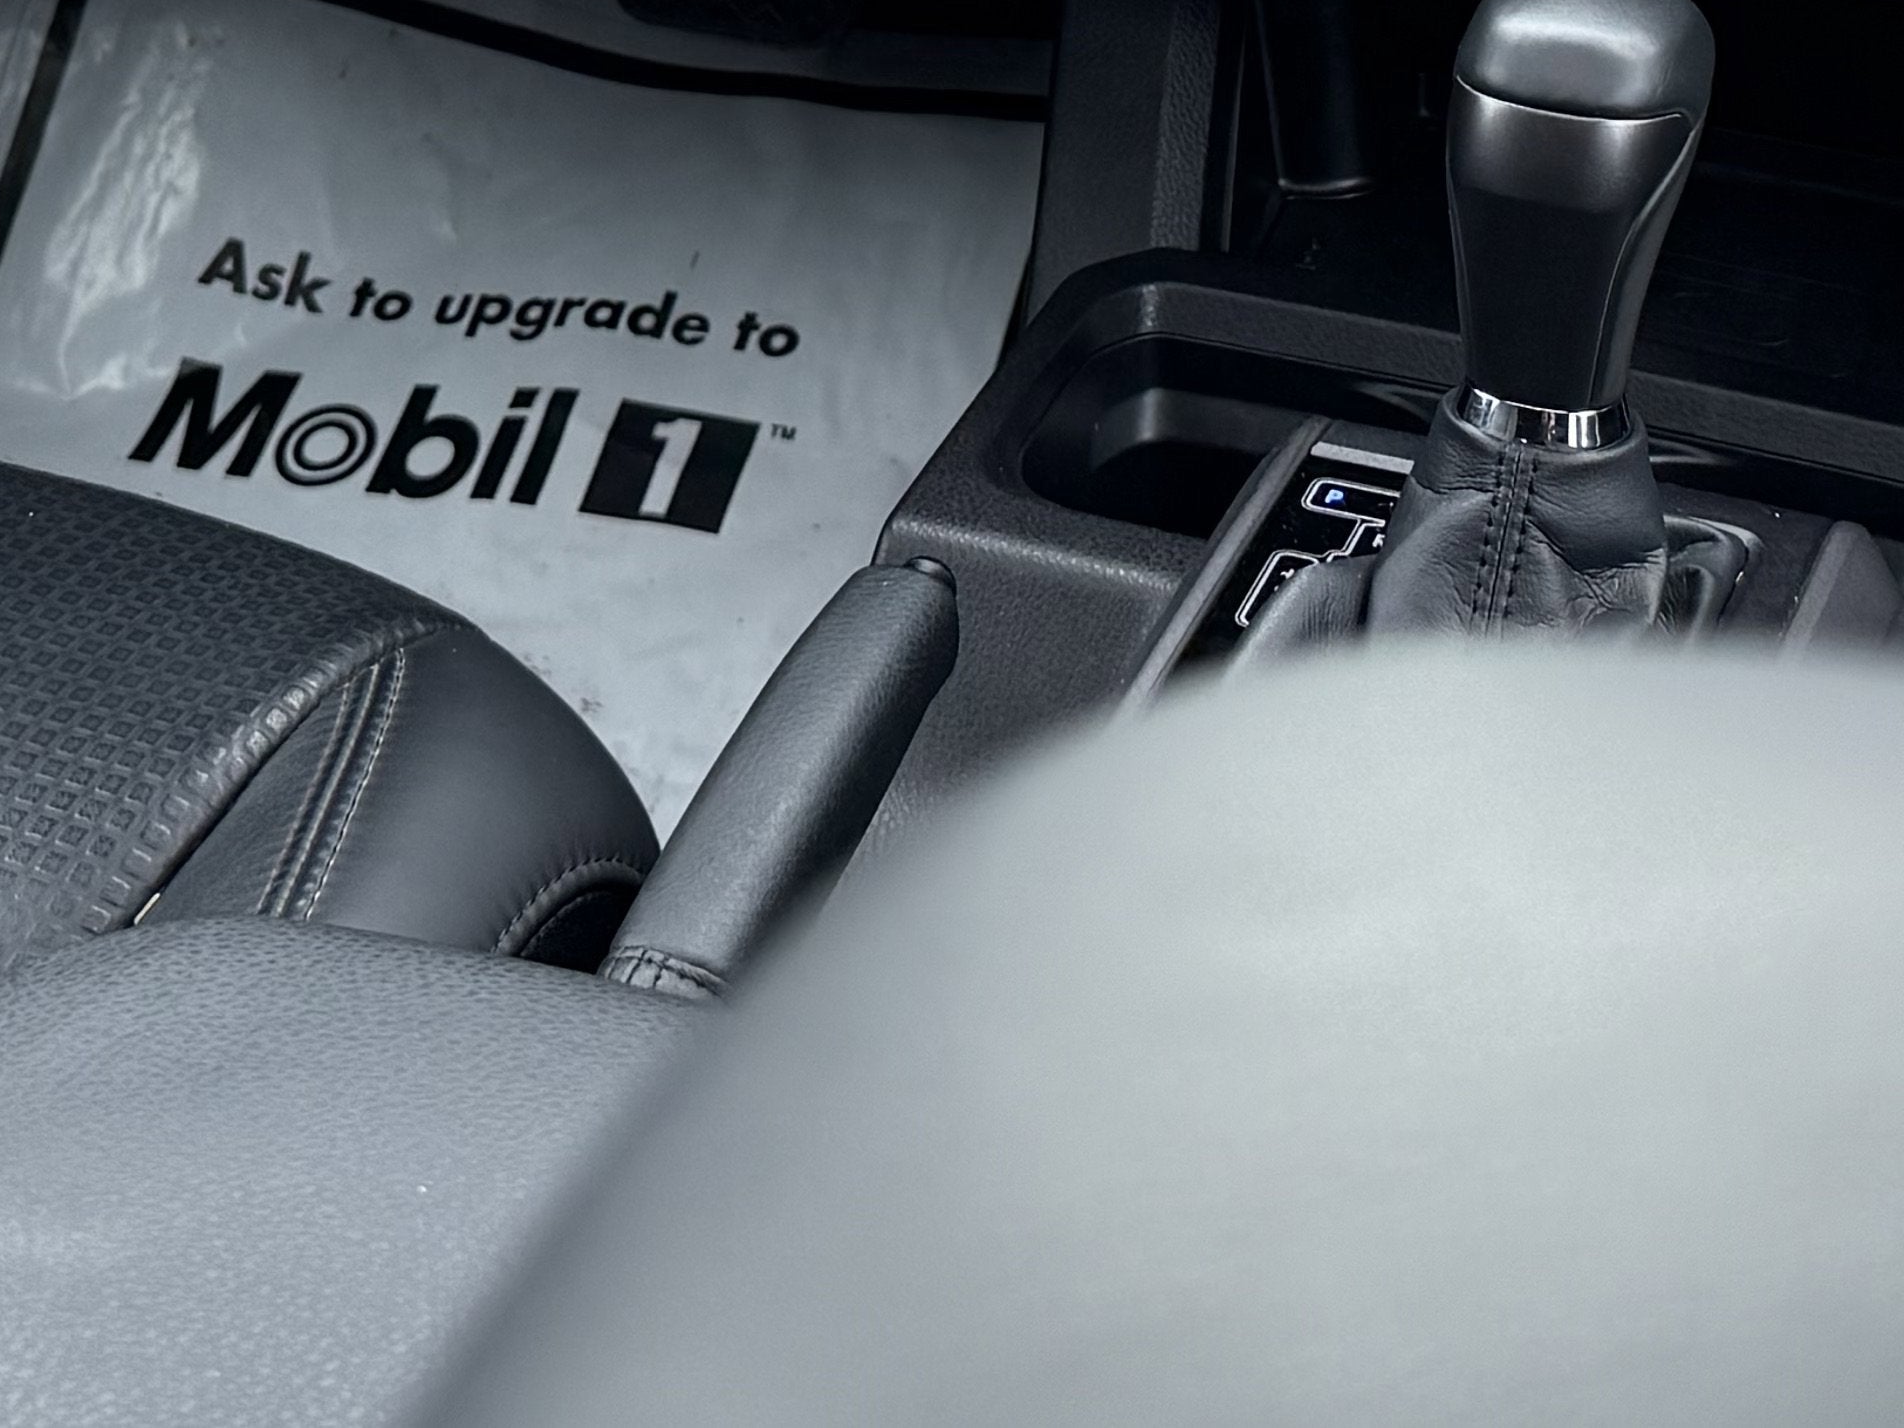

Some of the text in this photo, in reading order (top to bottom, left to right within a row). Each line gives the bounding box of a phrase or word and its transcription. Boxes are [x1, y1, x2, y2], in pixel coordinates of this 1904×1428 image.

[197, 236, 802, 359] Ask to upgrade to
[126, 355, 582, 508] Mobil
[1324, 488, 1344, 504] P
